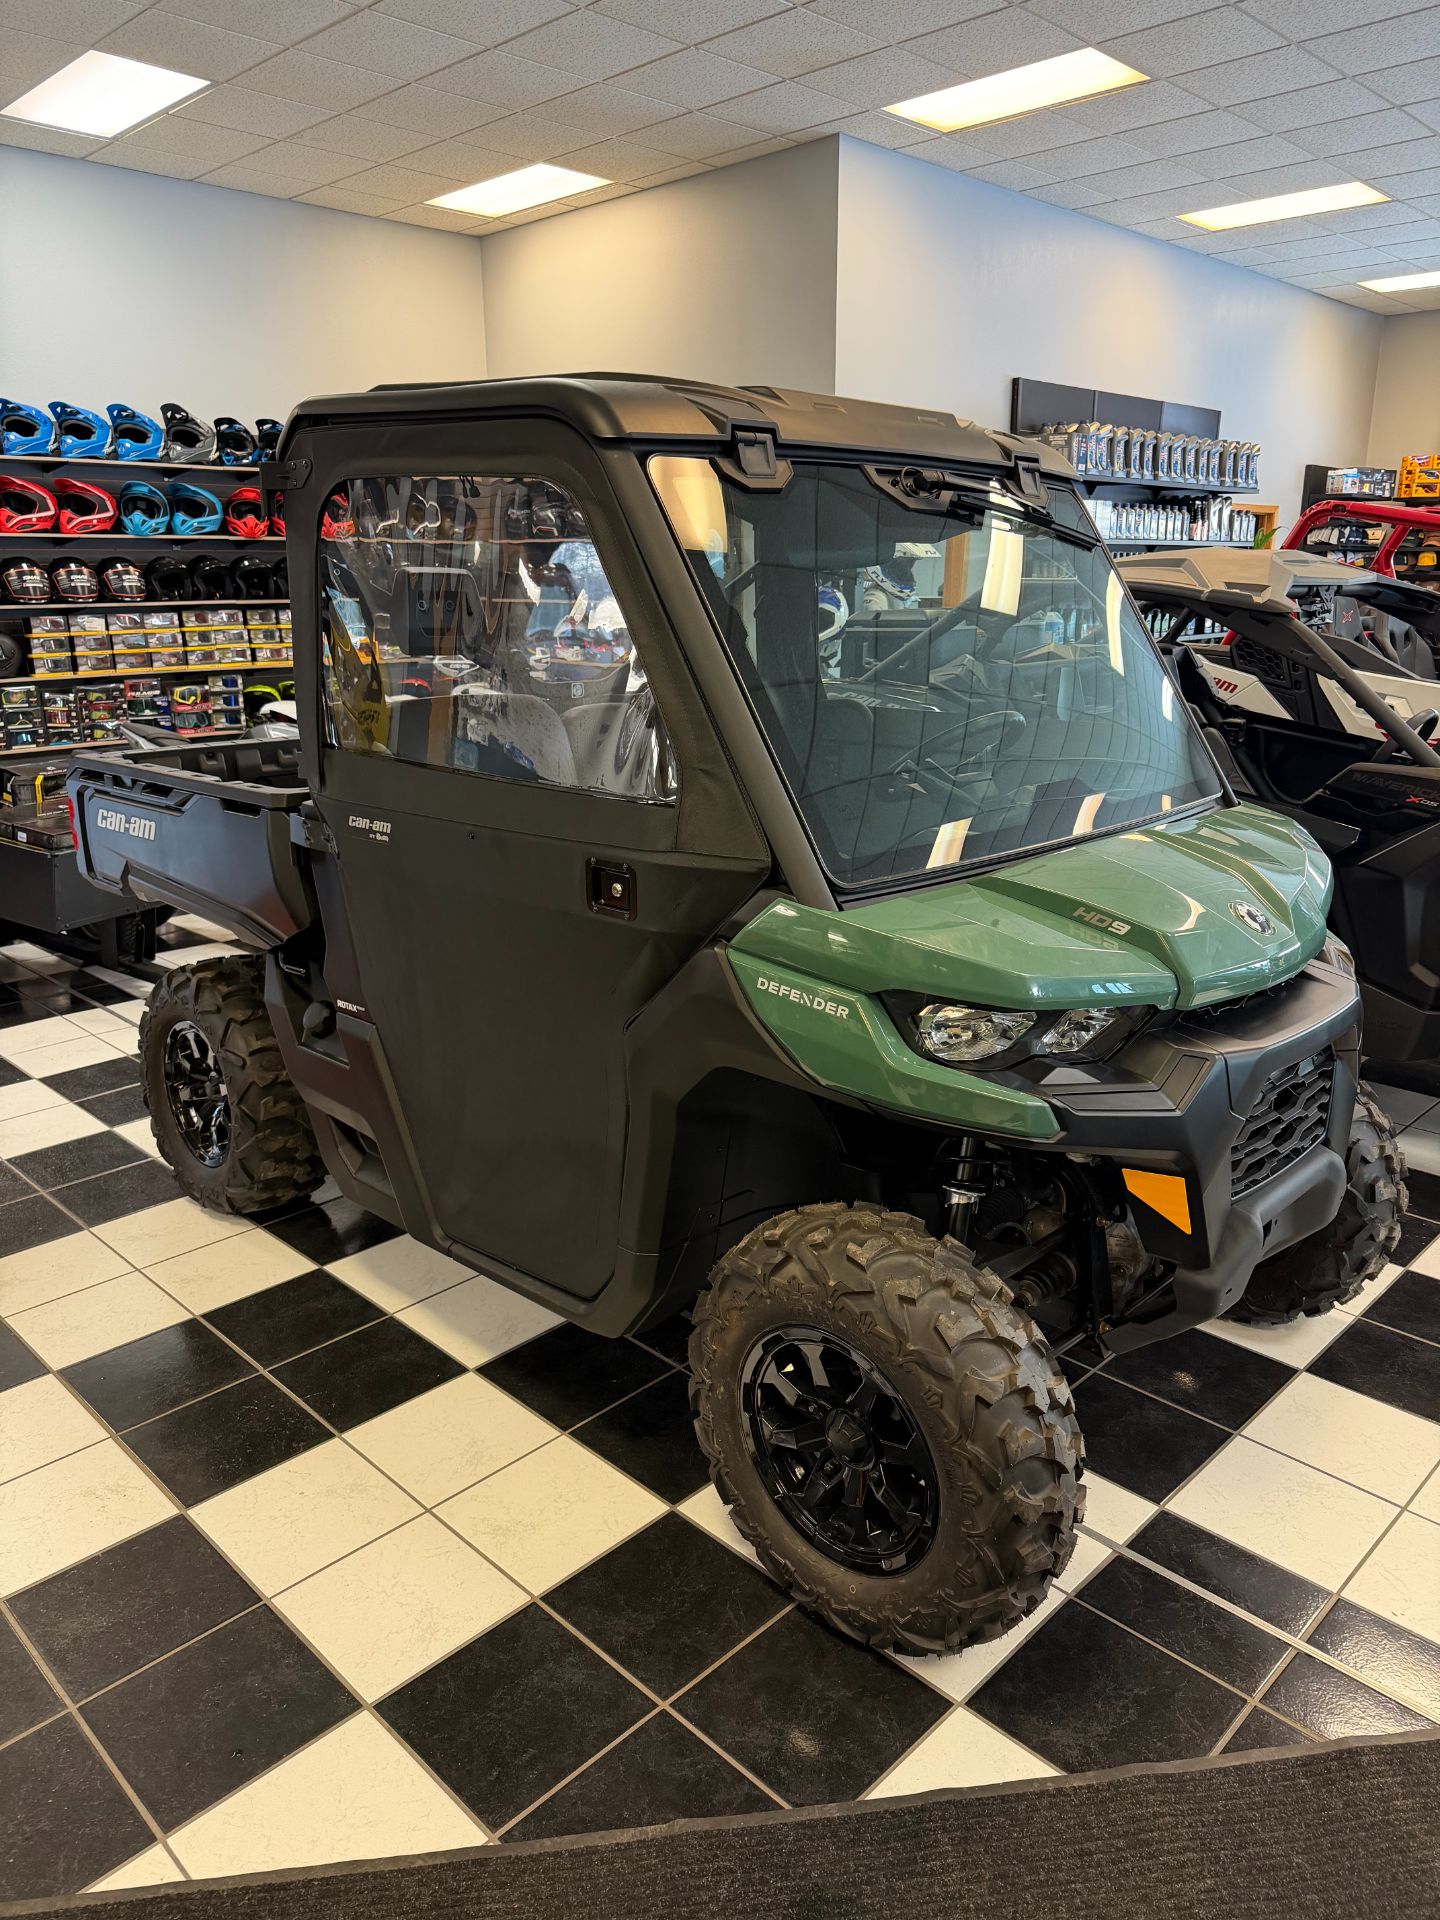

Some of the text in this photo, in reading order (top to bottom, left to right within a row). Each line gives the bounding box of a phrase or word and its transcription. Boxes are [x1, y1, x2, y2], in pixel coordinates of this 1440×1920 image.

[97, 808, 156, 841] can-am
[348, 815, 392, 834] can-am
[1072, 906, 1132, 936] HD9
[336, 999, 358, 1013] ROTAX
[756, 976, 850, 1019] DEFENDER
